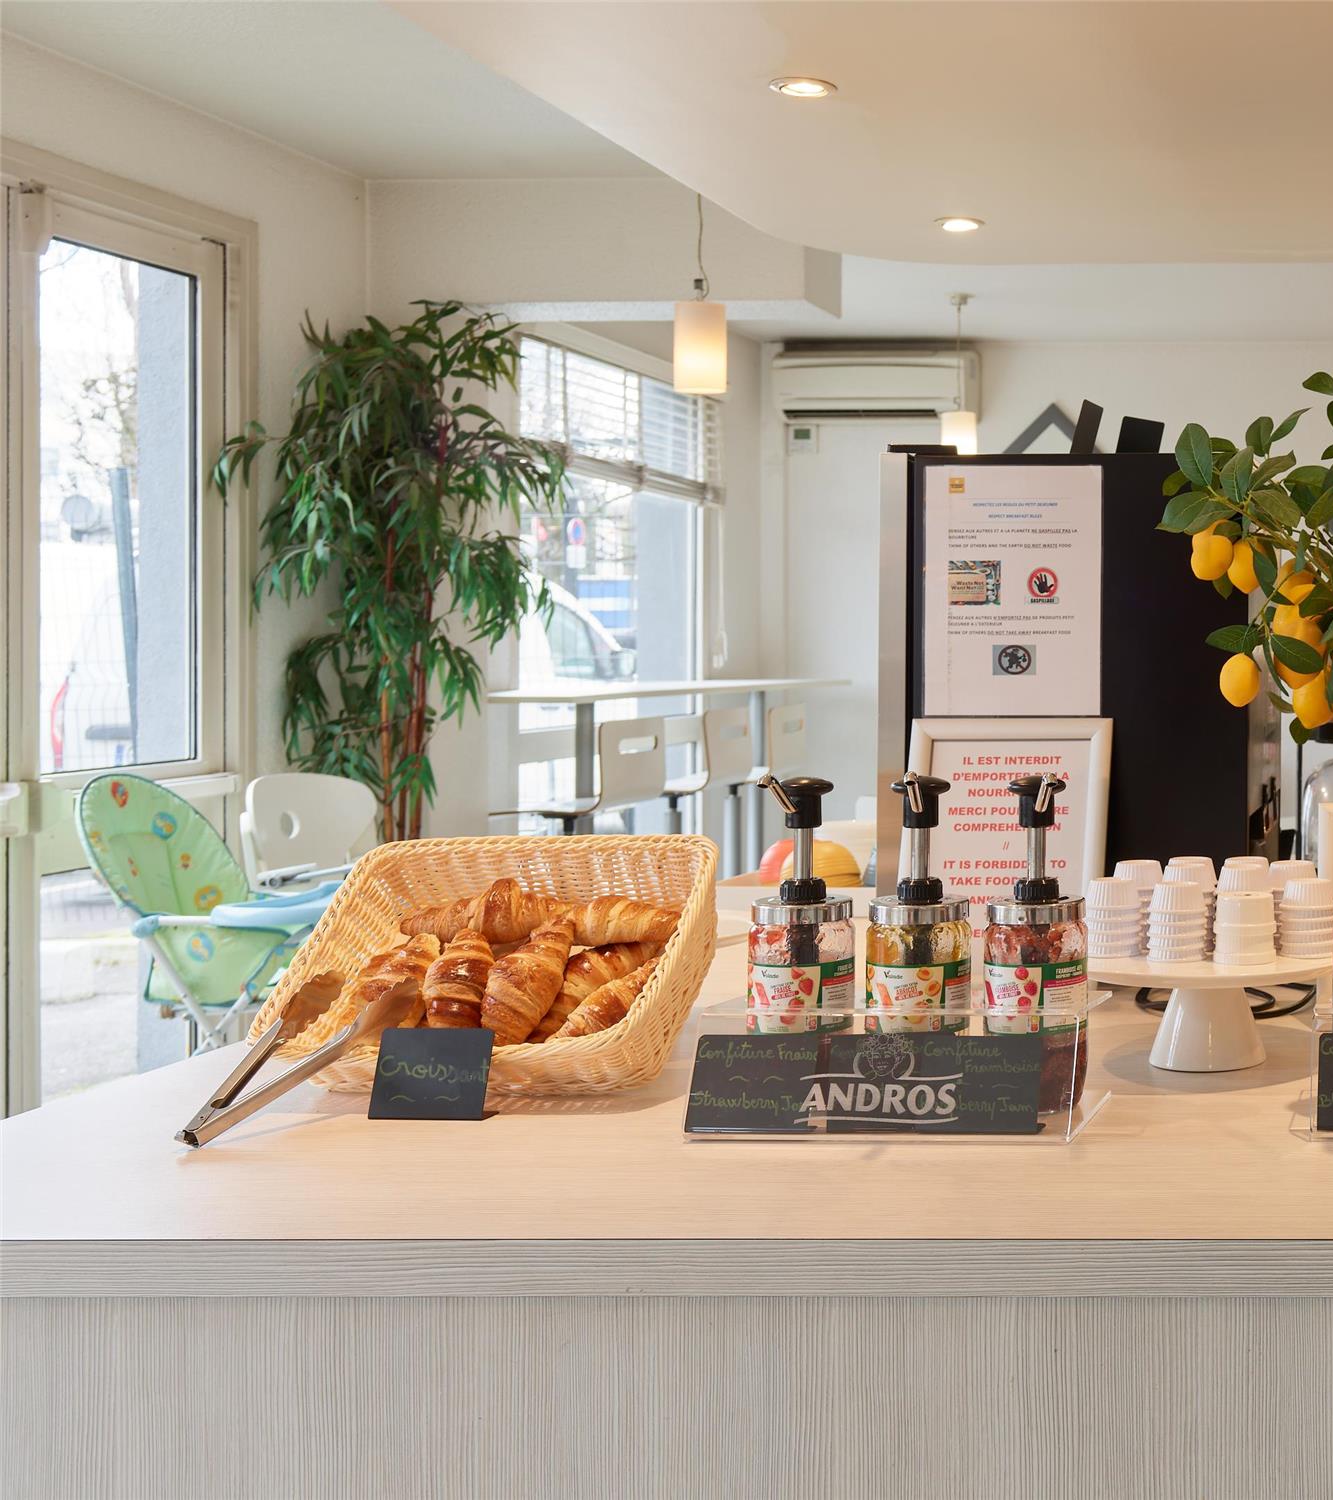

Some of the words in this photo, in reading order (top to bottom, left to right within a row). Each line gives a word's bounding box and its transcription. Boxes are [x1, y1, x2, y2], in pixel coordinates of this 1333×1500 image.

[962, 757, 974, 765] IL
[977, 756, 1001, 765] EST
[1004, 756, 1062, 765] INTERDIT
[948, 806, 987, 816] MERCI
[990, 806, 1020, 816] POU
[953, 823, 1061, 832] COMPREHEN
[943, 861, 955, 869] IT
[959, 860, 971, 869] IS
[974, 860, 1029, 869] FORBIDD
[1050, 860, 1066, 868] TO
[949, 877, 981, 885] TAKE
[699, 1041, 776, 1068] Confiture
[923, 1040, 1002, 1066] Confiture
[799, 1082, 957, 1116] ANDROS
